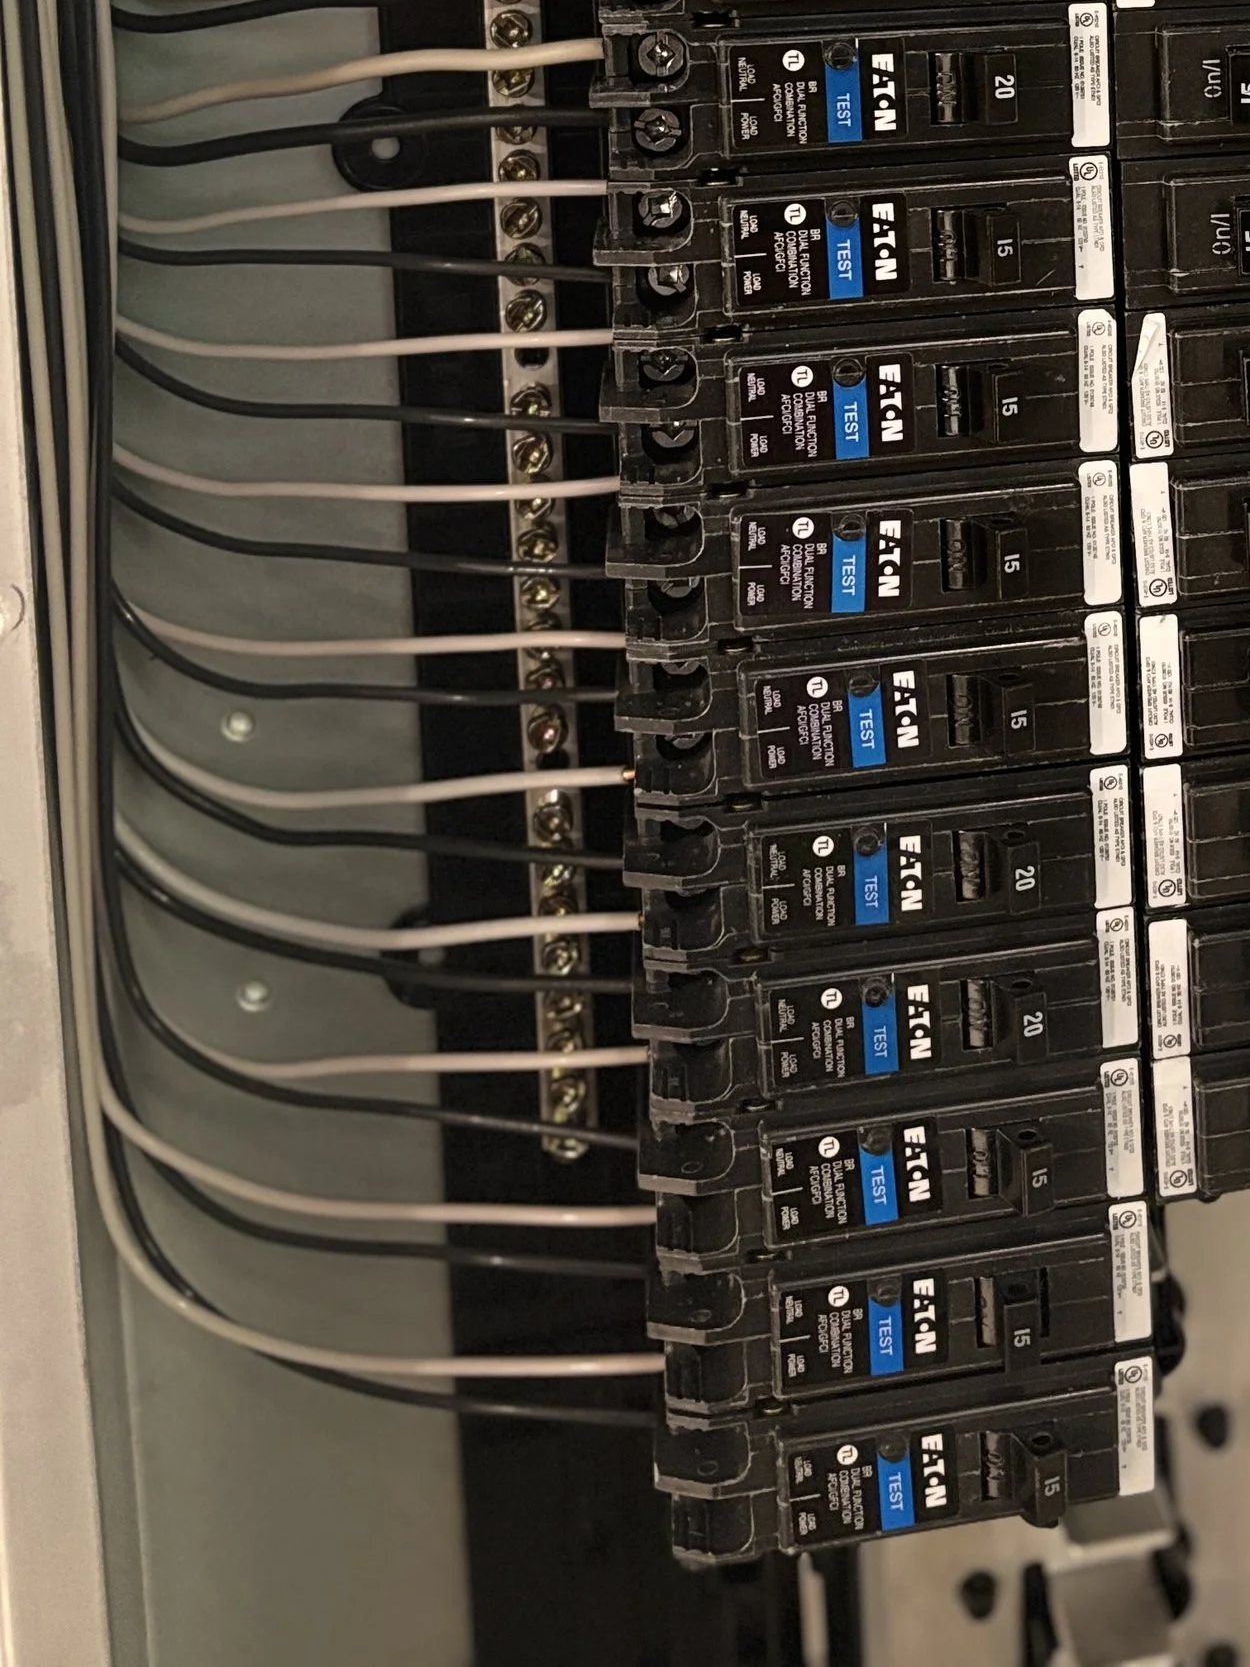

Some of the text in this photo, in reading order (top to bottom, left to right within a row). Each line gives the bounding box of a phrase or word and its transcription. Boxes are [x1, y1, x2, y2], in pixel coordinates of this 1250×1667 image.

[871, 53, 896, 132] EATON
[994, 75, 1015, 100] 20
[836, 92, 851, 128] TEST
[739, 209, 749, 240] NEUTRAL
[748, 214, 758, 235] LOAD
[810, 229, 820, 241] BR
[872, 202, 898, 281] EATON
[773, 231, 785, 273] AFCI/GFCI
[785, 230, 798, 289] COMBINATION
[797, 229, 811, 296] DUAL FUNCTION
[836, 239, 852, 282] TEST
[998, 239, 1013, 257] 15
[743, 270, 753, 296] POWER
[752, 272, 761, 294] LOAD
[842, 401, 859, 443] TEST
[878, 363, 904, 442] EATON
[1002, 397, 1018, 416] 15
[841, 555, 855, 597] TEST
[879, 519, 899, 597] EATON
[1004, 554, 1019, 573] 15
[858, 708, 875, 751] TEST
[892, 670, 920, 749] EATON
[1010, 709, 1027, 729] 15
[864, 875, 878, 909] TEST
[901, 835, 922, 911] EATON
[1016, 865, 1035, 891] 20
[873, 1024, 888, 1059] TEST
[907, 984, 932, 1060] EATON
[1024, 1011, 1043, 1037] 20
[903, 1126, 930, 1203] EATON
[1032, 1168, 1047, 1189] 15
[871, 1165, 888, 1206] TEST
[913, 1277, 937, 1354] EATON
[878, 1316, 894, 1356] TEST
[1014, 1328, 1030, 1347] 15
[921, 1433, 947, 1508] EATON
[1044, 1478, 1060, 1495] 15
[887, 1472, 904, 1512] TEST
